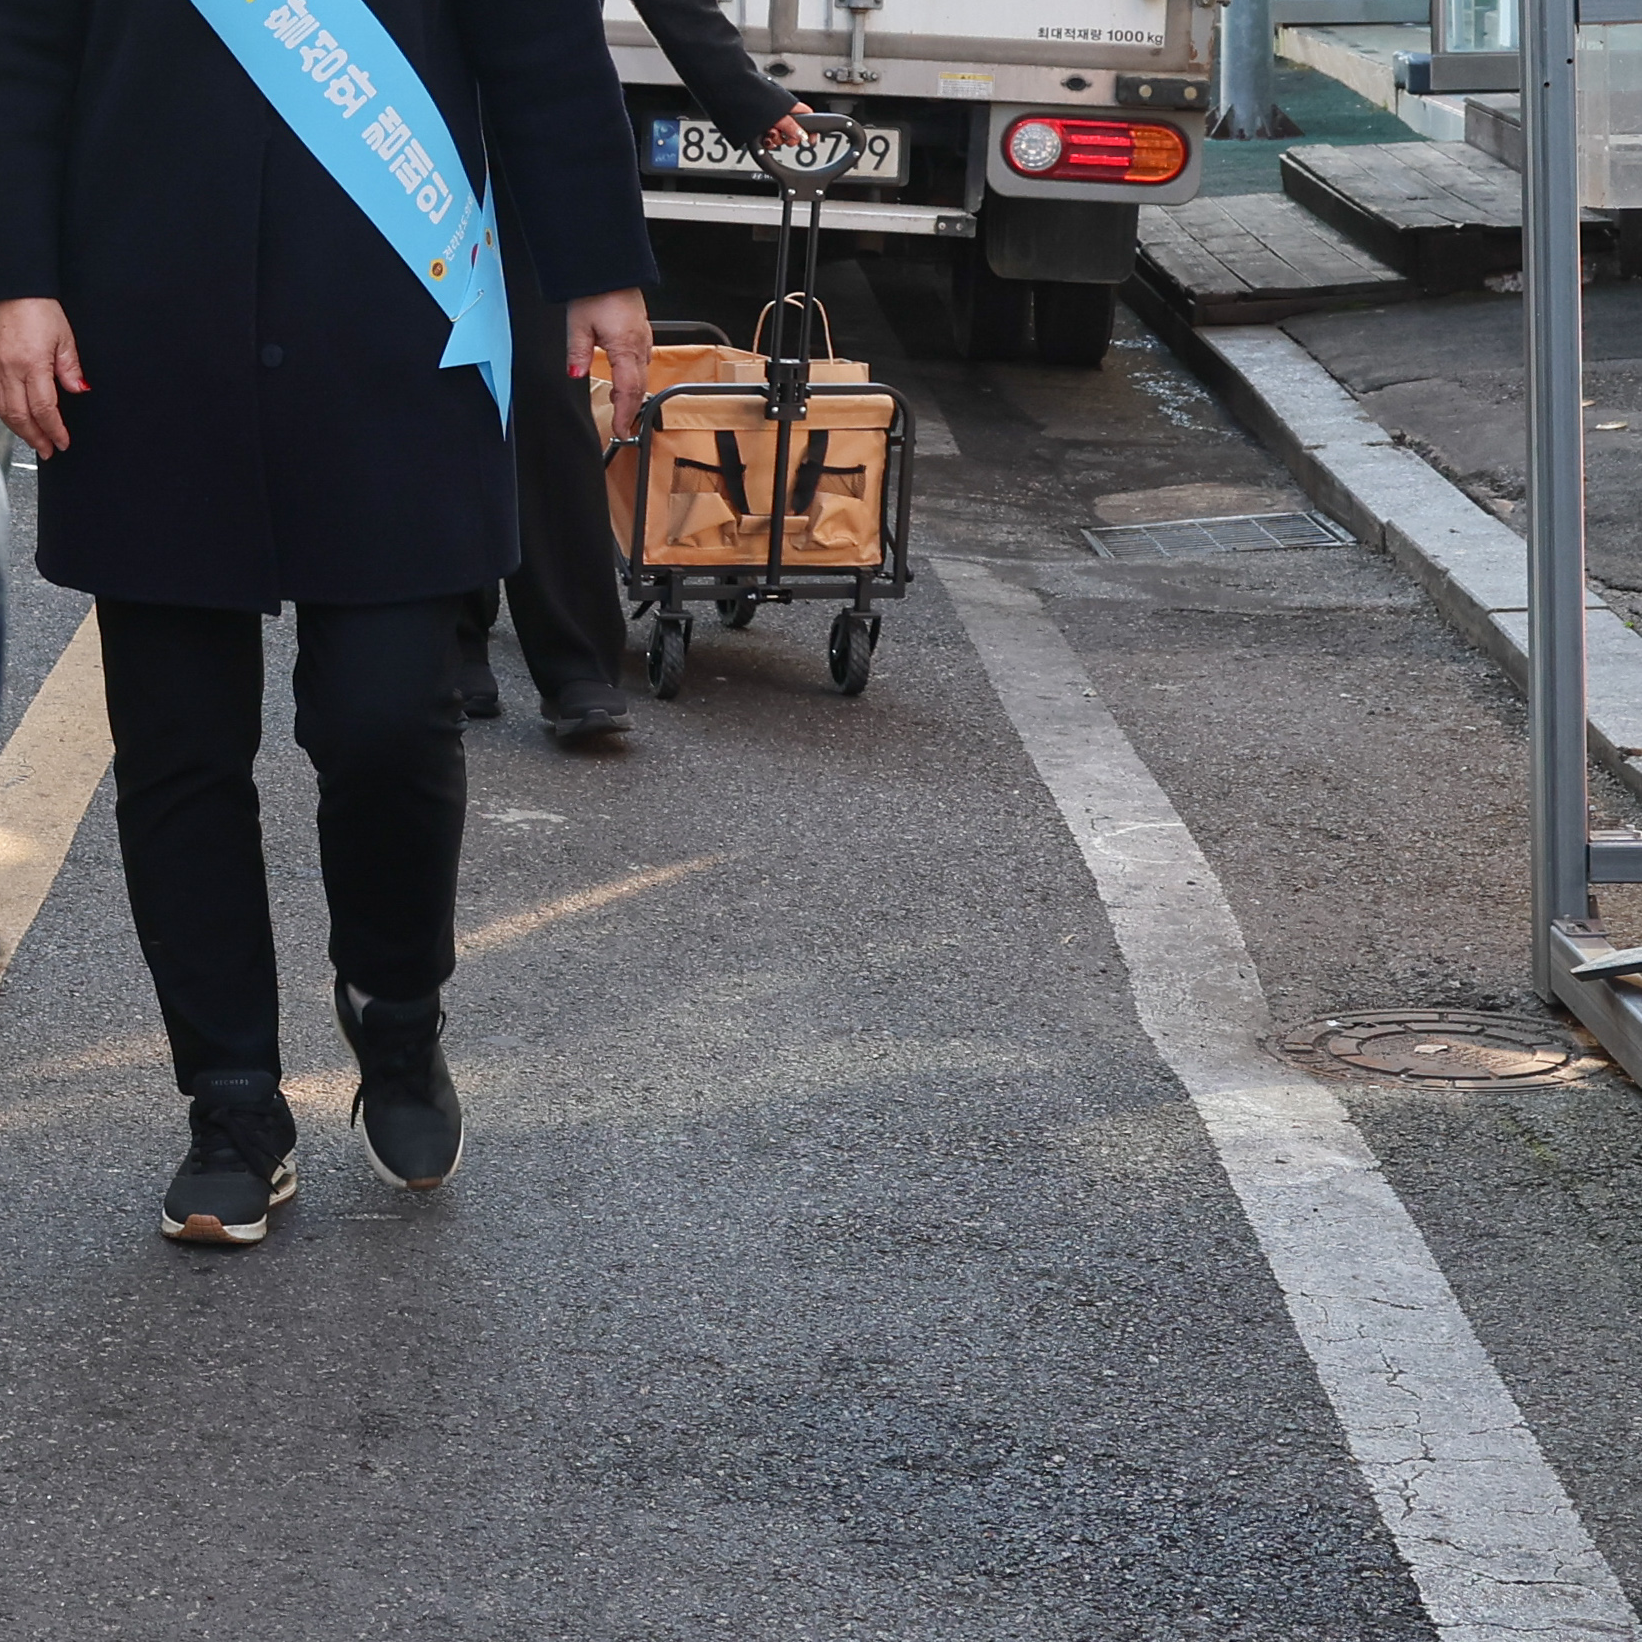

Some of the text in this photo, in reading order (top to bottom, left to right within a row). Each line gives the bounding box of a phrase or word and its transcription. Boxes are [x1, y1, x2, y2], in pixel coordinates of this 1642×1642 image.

[1037, 27, 1164, 46] 최대적재량 1000 kg
[361, 105, 454, 226] 캠페인
